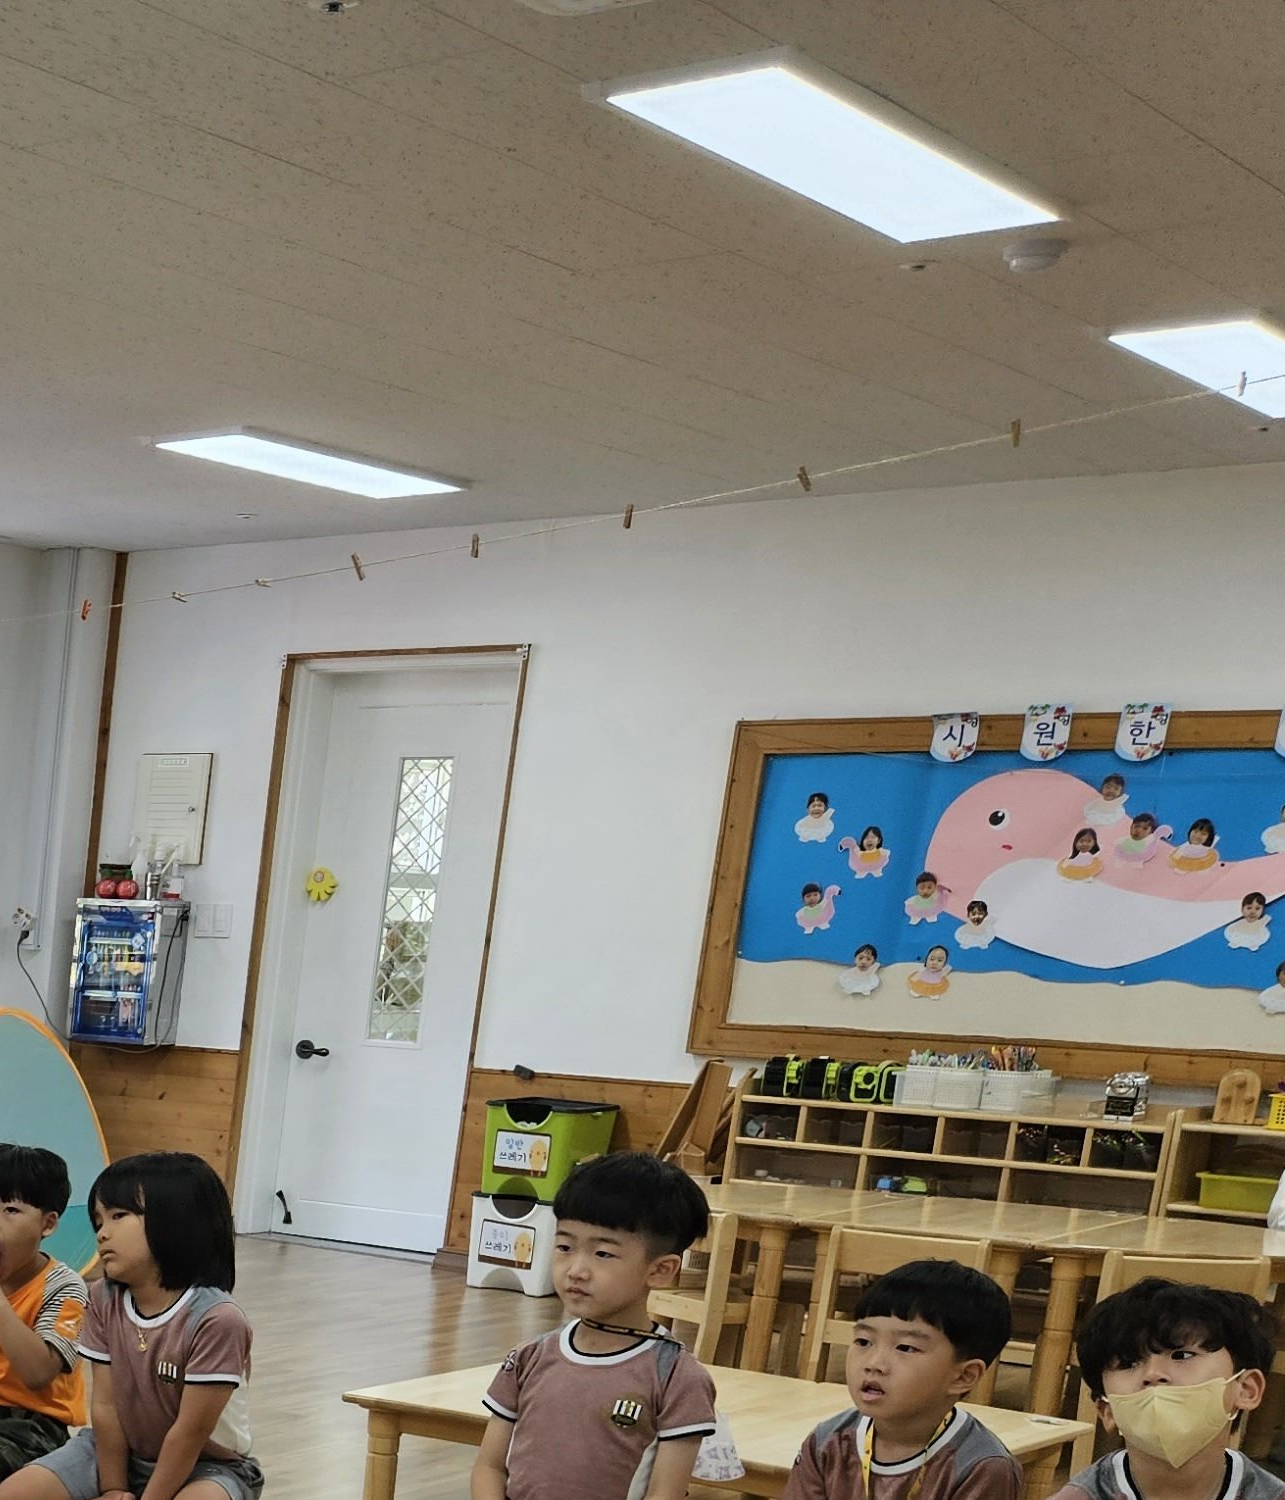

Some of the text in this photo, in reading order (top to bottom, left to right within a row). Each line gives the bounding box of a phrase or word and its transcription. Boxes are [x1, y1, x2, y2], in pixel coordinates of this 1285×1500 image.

[942, 720, 1156, 747] 시 원 한
[505, 1137, 525, 1150] 일반
[499, 1151, 527, 1163] 쓰레기
[485, 1241, 512, 1254] 쓰레기
